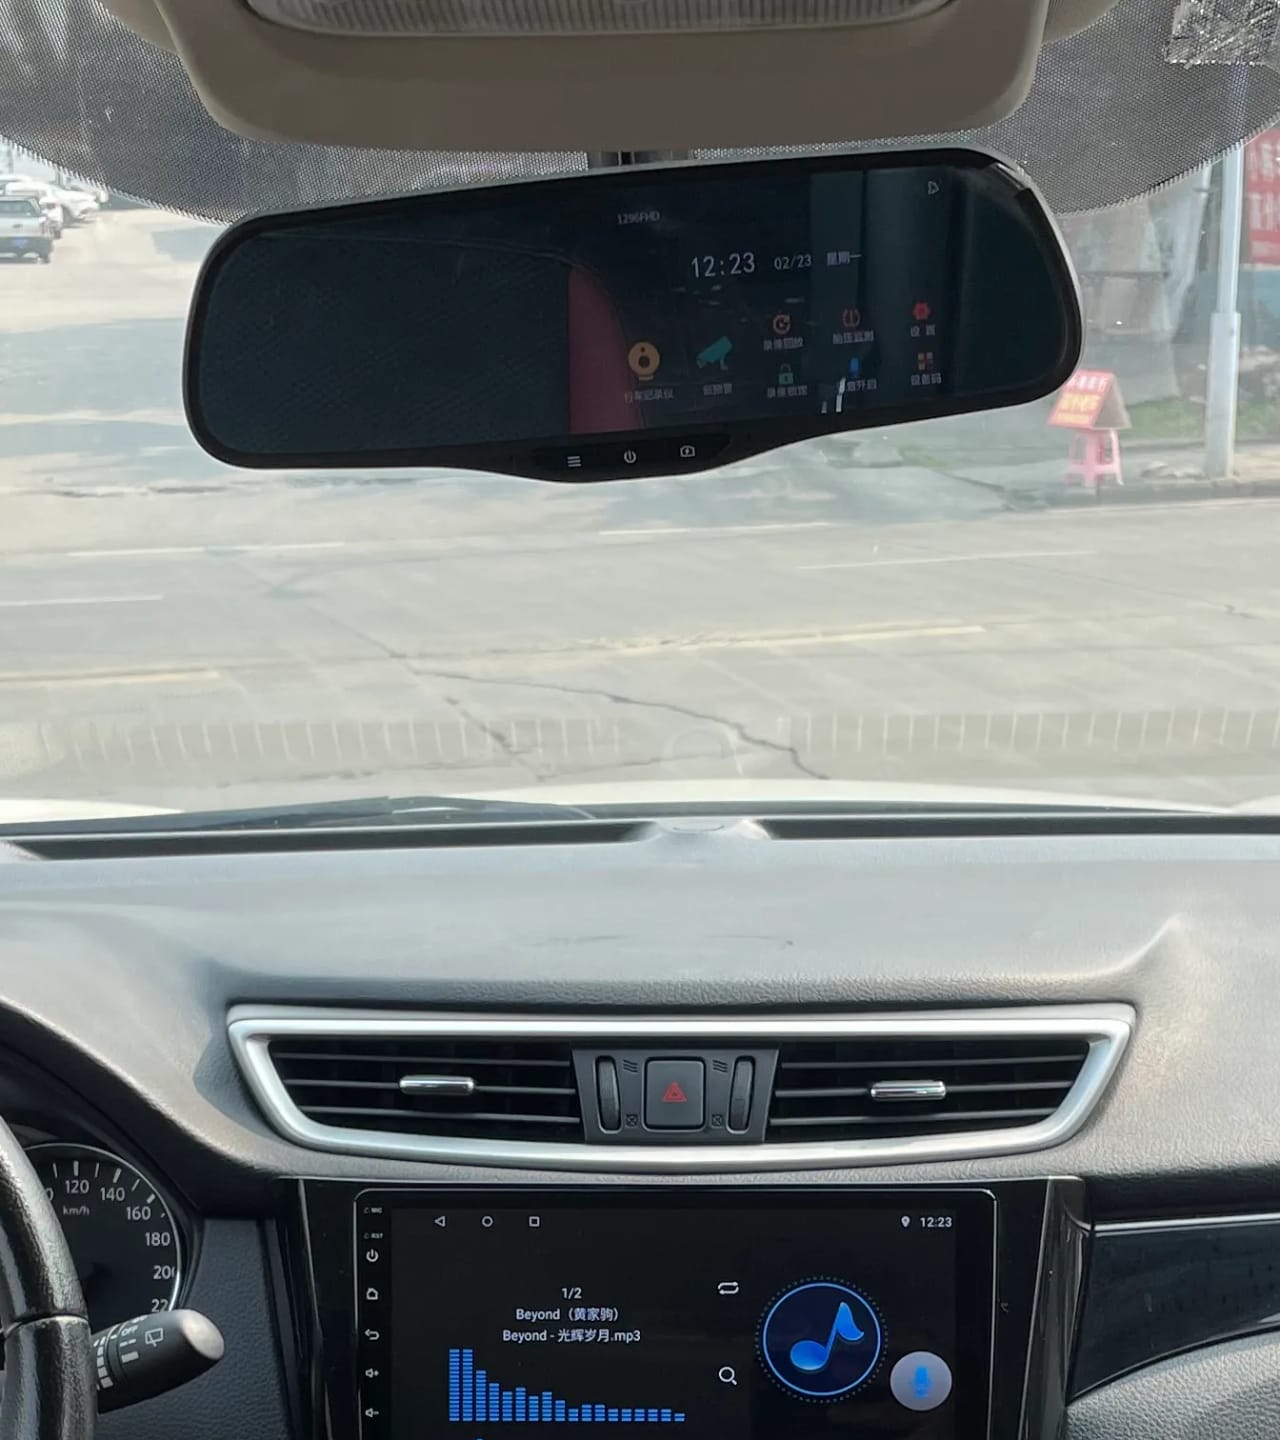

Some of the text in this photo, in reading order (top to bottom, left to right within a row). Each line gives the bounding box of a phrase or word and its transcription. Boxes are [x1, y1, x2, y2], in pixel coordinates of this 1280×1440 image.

[691, 250, 863, 278] 12:23 02/23 星期一
[64, 1180, 90, 1194] 120
[100, 1187, 126, 1201] 140
[62, 1205, 91, 1217] km/h
[125, 1206, 152, 1220] 160
[920, 1216, 953, 1228] 12:23
[145, 1232, 171, 1247] 180
[561, 1287, 583, 1300] 1/2
[515, 1308, 561, 1323] Beyond
[120, 1325, 140, 1337] OFF
[502, 1329, 548, 1344] Beyond
[557, 1328, 641, 1344] 光辉岁月.mp3
